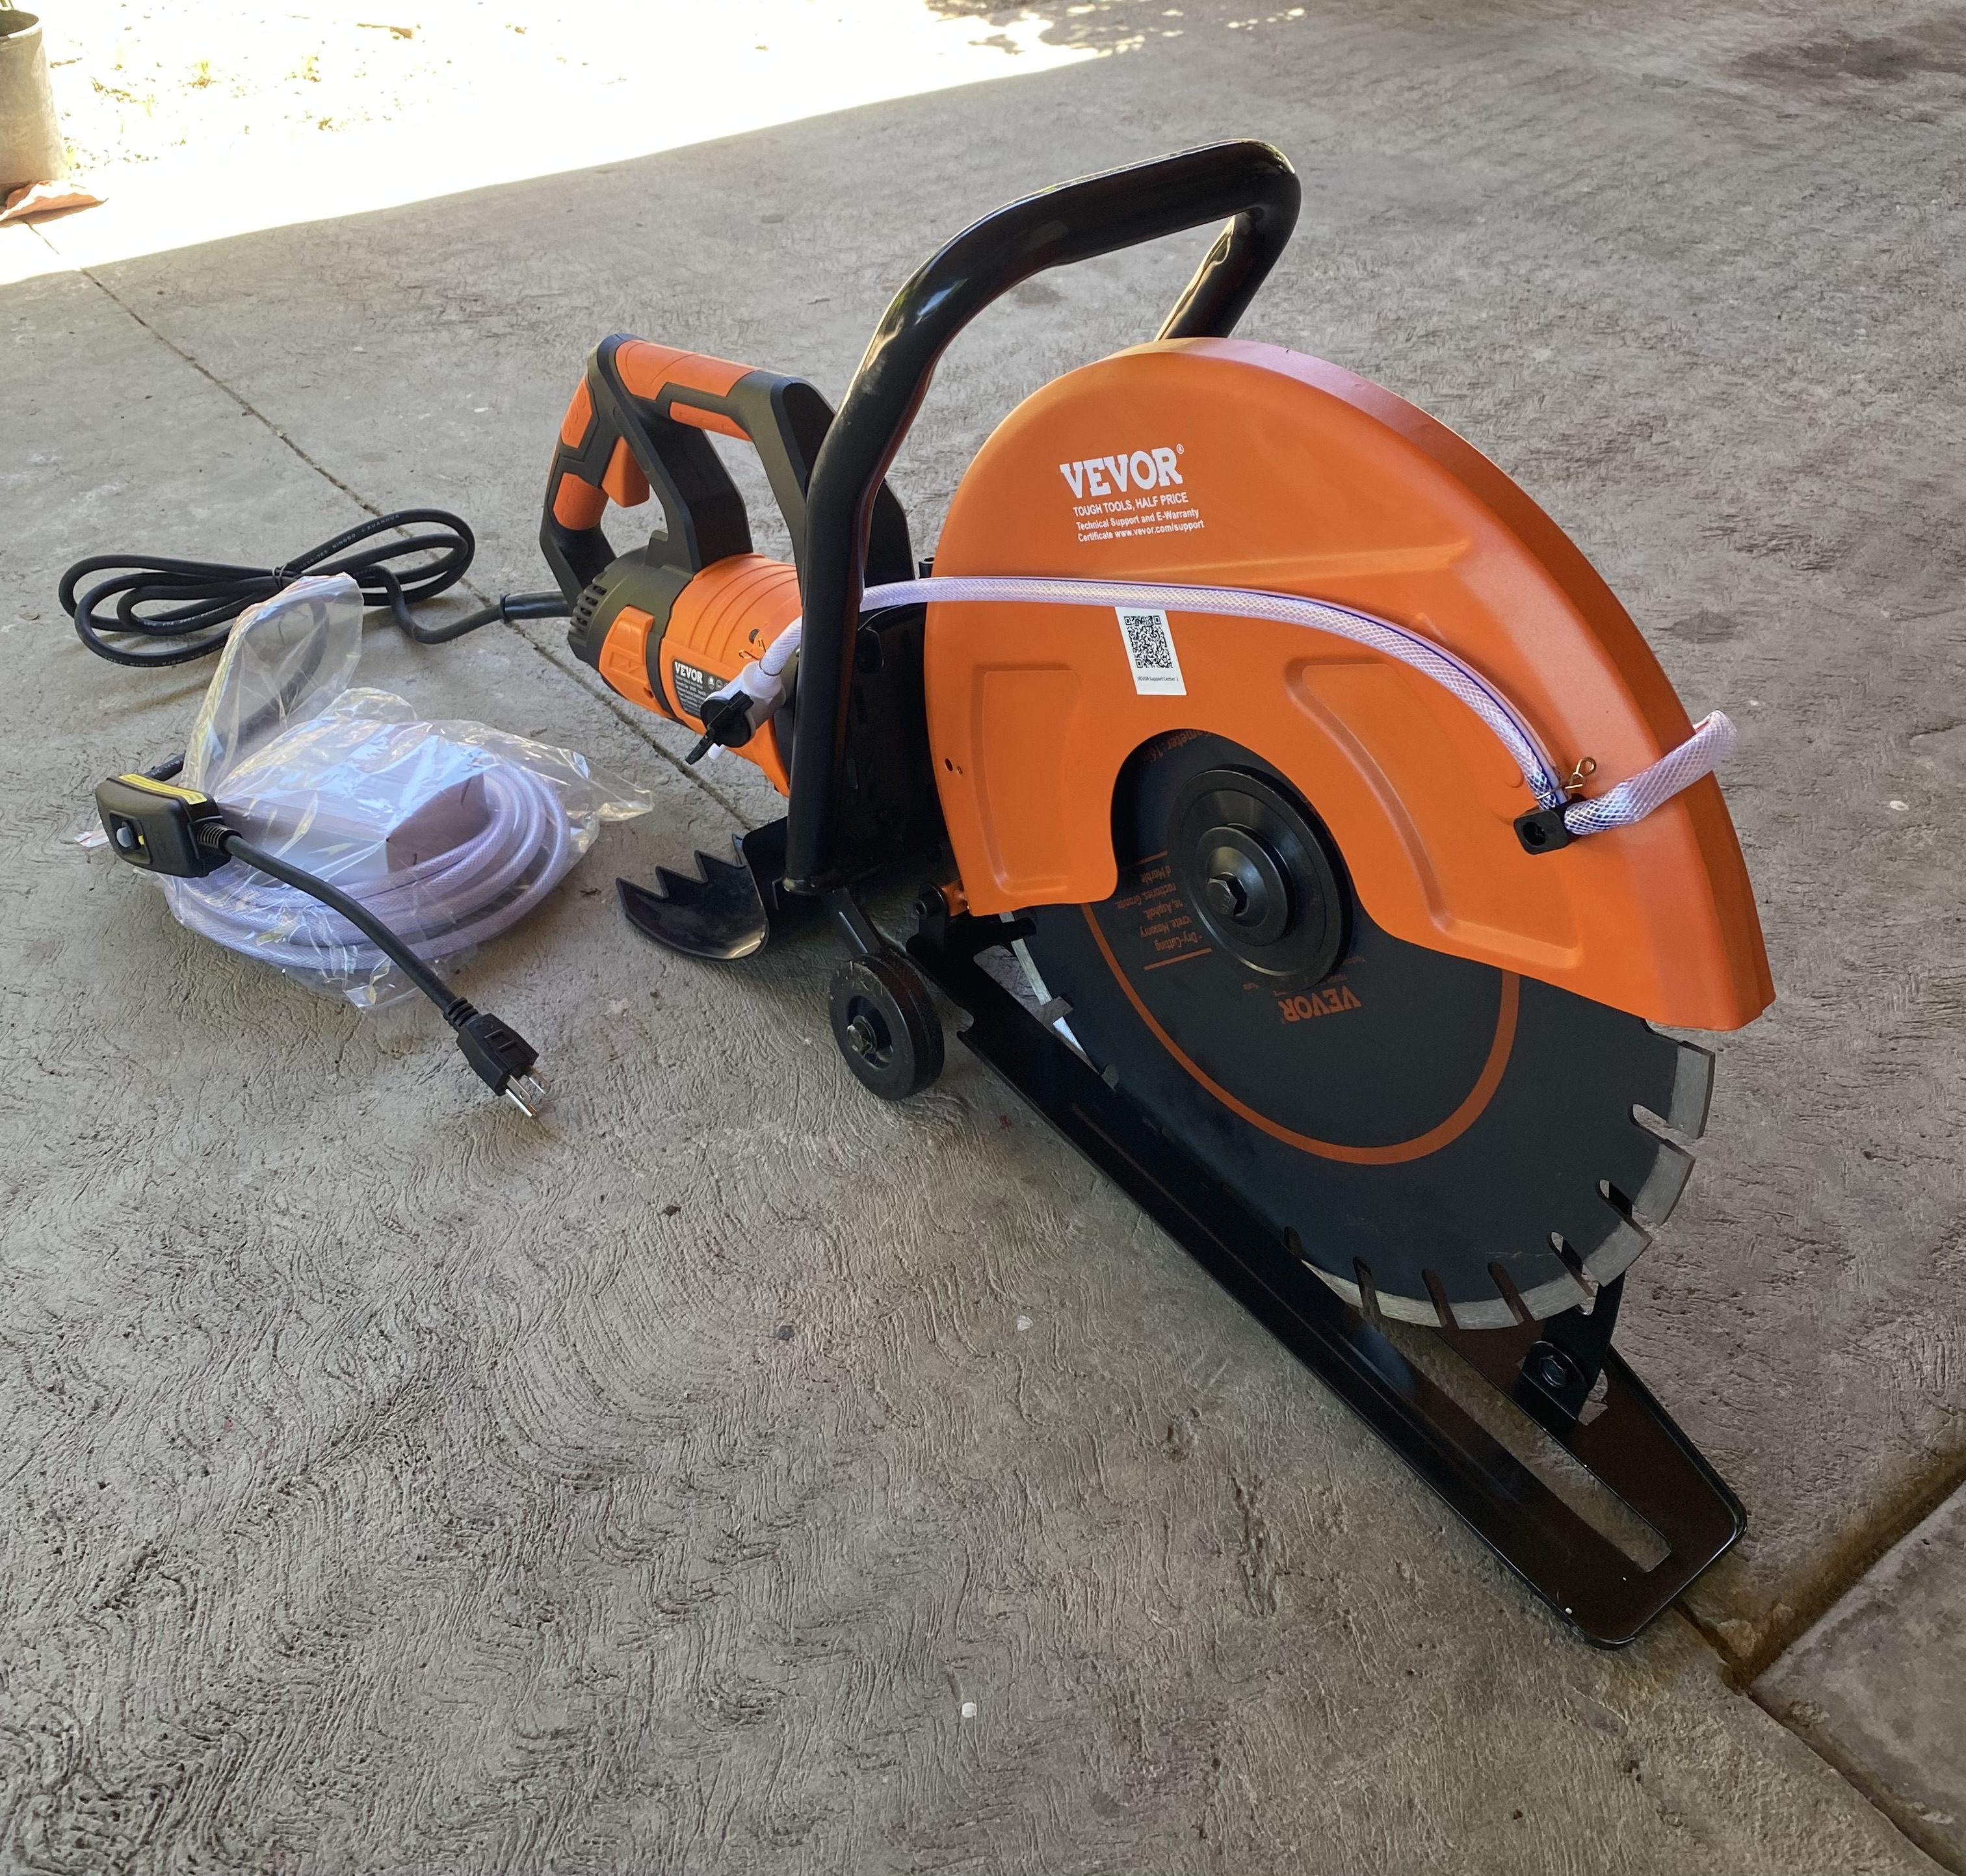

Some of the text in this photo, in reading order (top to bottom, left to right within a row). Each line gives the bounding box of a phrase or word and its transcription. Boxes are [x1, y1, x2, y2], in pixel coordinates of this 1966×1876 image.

[1073, 492, 1188, 516] TOUGH TOOLS, HALF PRICE
[1076, 508, 1199, 531] Technical Support and E-Warranty
[1078, 520, 1204, 542] Certificate www.vevor.com/support
[674, 661, 703, 684] VEVOR
